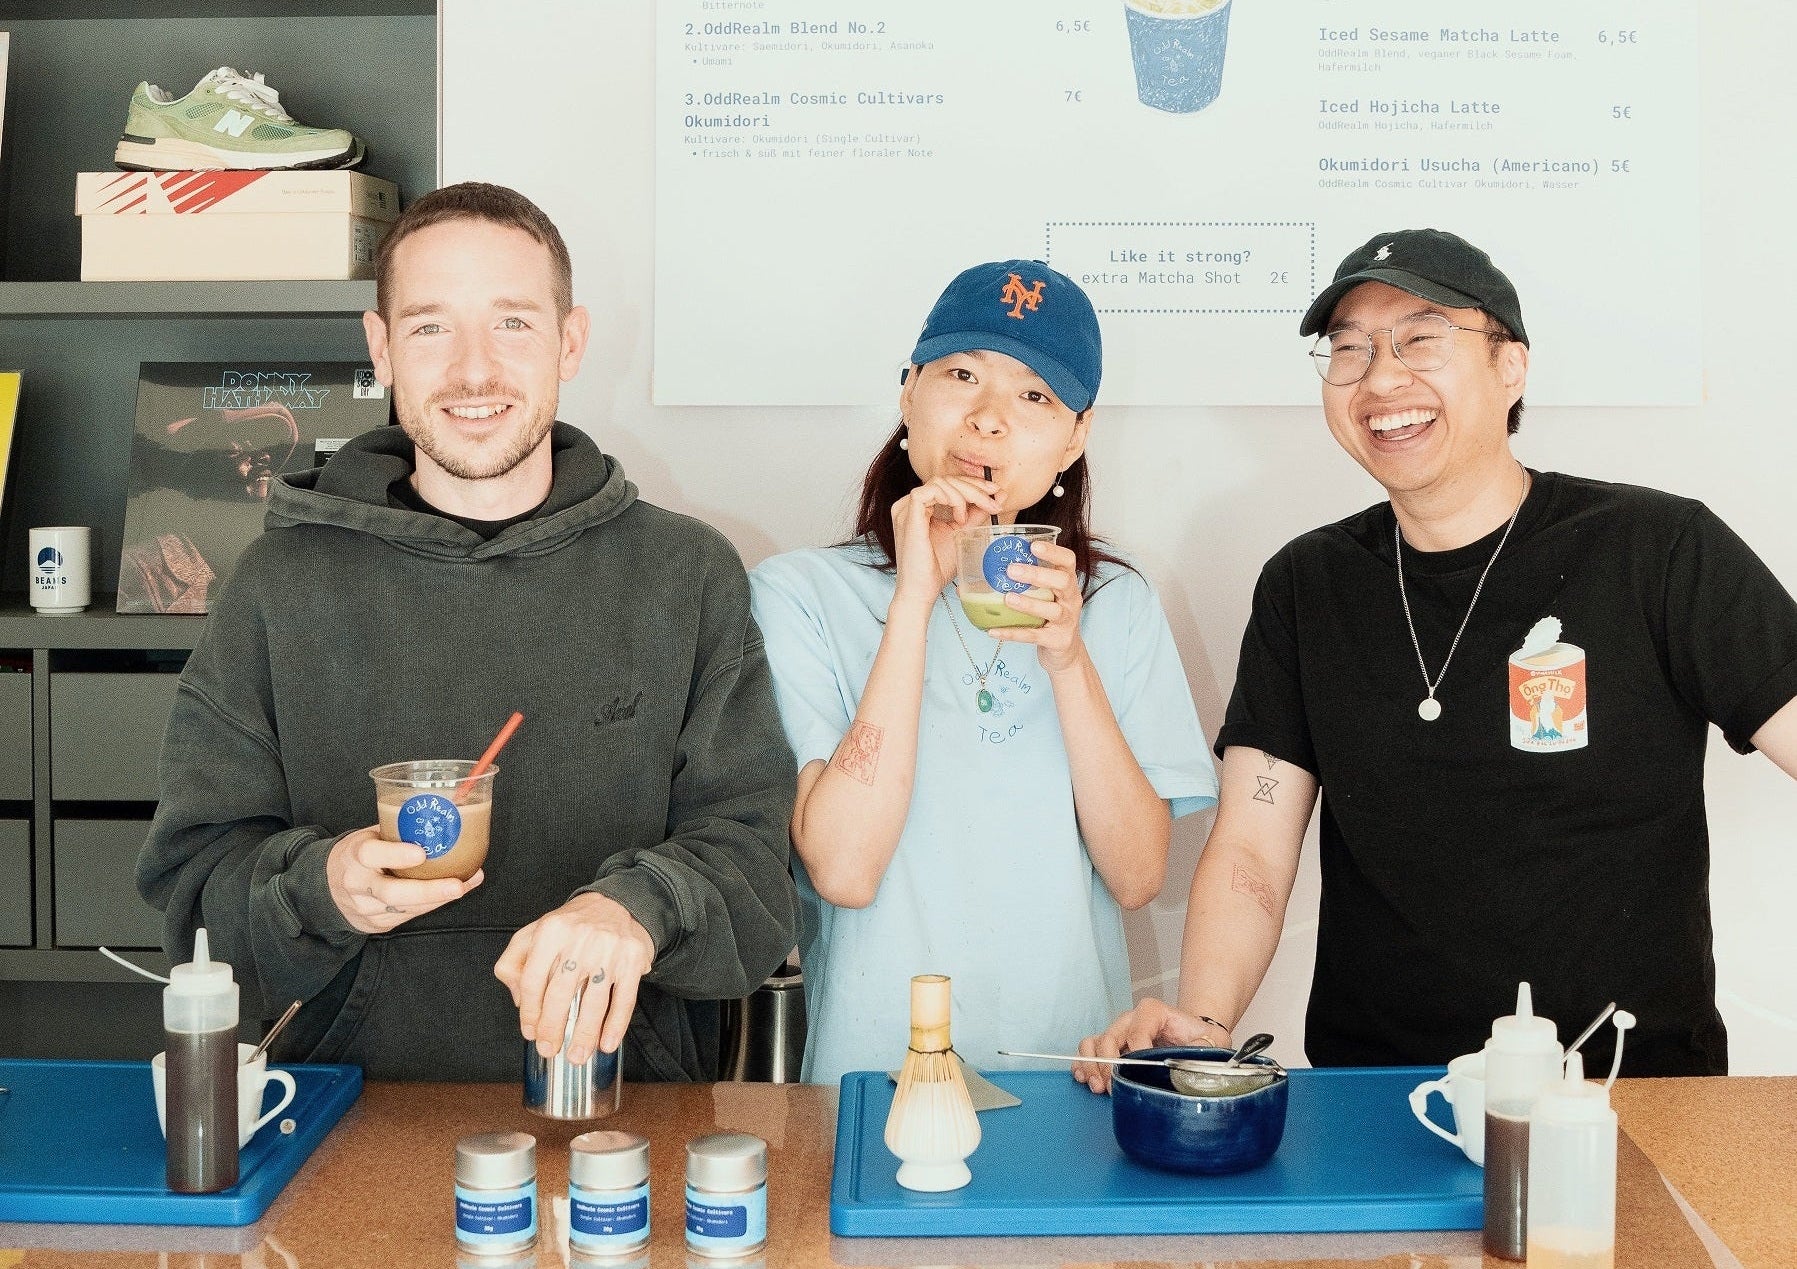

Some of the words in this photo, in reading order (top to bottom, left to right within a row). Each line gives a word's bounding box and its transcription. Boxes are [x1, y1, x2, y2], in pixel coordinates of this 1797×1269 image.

[685, 21, 780, 35] 2.OddRealm
[790, 21, 838, 34] Blend
[848, 21, 886, 34] No.2
[1056, 20, 1090, 34] 6,5€
[1319, 27, 1358, 41] Iced
[1369, 28, 1429, 41] Sesame
[1440, 28, 1499, 42] Matcha
[1511, 29, 1559, 42] Latte
[1598, 30, 1637, 46] 6,5€
[685, 42, 745, 52] Kultivare:
[821, 41, 881, 51] Okumidori,
[890, 41, 934, 50] Asanoka
[1467, 49, 1498, 59] Black
[702, 57, 732, 66] Umami
[1318, 62, 1381, 72] Hafermilch
[685, 92, 780, 105] 3.OddRealm
[790, 92, 847, 105] Cosmic
[857, 91, 944, 104] Cultivars
[1065, 90, 1081, 102] 7€
[1320, 99, 1358, 113] Iced
[1370, 99, 1439, 116] Hojicha
[1451, 100, 1500, 114] Latte
[1612, 106, 1631, 119] 5€
[213, 109, 255, 138] N
[685, 114, 770, 128] Okumidori
[1431, 120, 1493, 131] Hafermilch
[684, 134, 745, 144] Kultivare:
[752, 134, 808, 144] Okumidori
[816, 133, 859, 145] (Single
[865, 133, 920, 144] Cultivar)
[702, 149, 739, 158] frisch
[745, 149, 751, 158] &
[782, 150, 800, 158] mit
[808, 147, 844, 158] feiner
[852, 148, 901, 157] floraler
[907, 149, 933, 157] Note
[1319, 157, 1409, 171] Okumidori
[1421, 158, 1480, 172] Usucha
[1493, 158, 1598, 176] (Americano)
[1611, 159, 1630, 173] 5€
[1318, 178, 1369, 189] OddRealm
[1374, 179, 1412, 189] Cosmic
[1418, 178, 1467, 188] Cultivar
[1474, 178, 1535, 190] Okumidori,
[1542, 180, 1579, 189] Wasser
[1110, 249, 1147, 262] Like
[1158, 250, 1175, 262] it
[1186, 250, 1251, 265] strong?
[1082, 272, 1128, 284] extra
[1138, 271, 1194, 284] Matcha
[1205, 271, 1241, 284] Shot
[1270, 271, 1288, 284] 2€
[1001, 272, 1045, 319] NY
[223, 371, 311, 396] DONNY
[203, 386, 330, 408] HATHAWAY
[993, 540, 1013, 553] Odd
[1014, 540, 1035, 565] Realm
[996, 576, 1025, 592] Tea
[962, 662, 989, 686] Odd
[995, 659, 1031, 695] Realm
[978, 722, 1024, 744] Tea
[407, 799, 427, 815] Odd
[429, 796, 455, 822] Realm
[414, 841, 447, 855] ea
